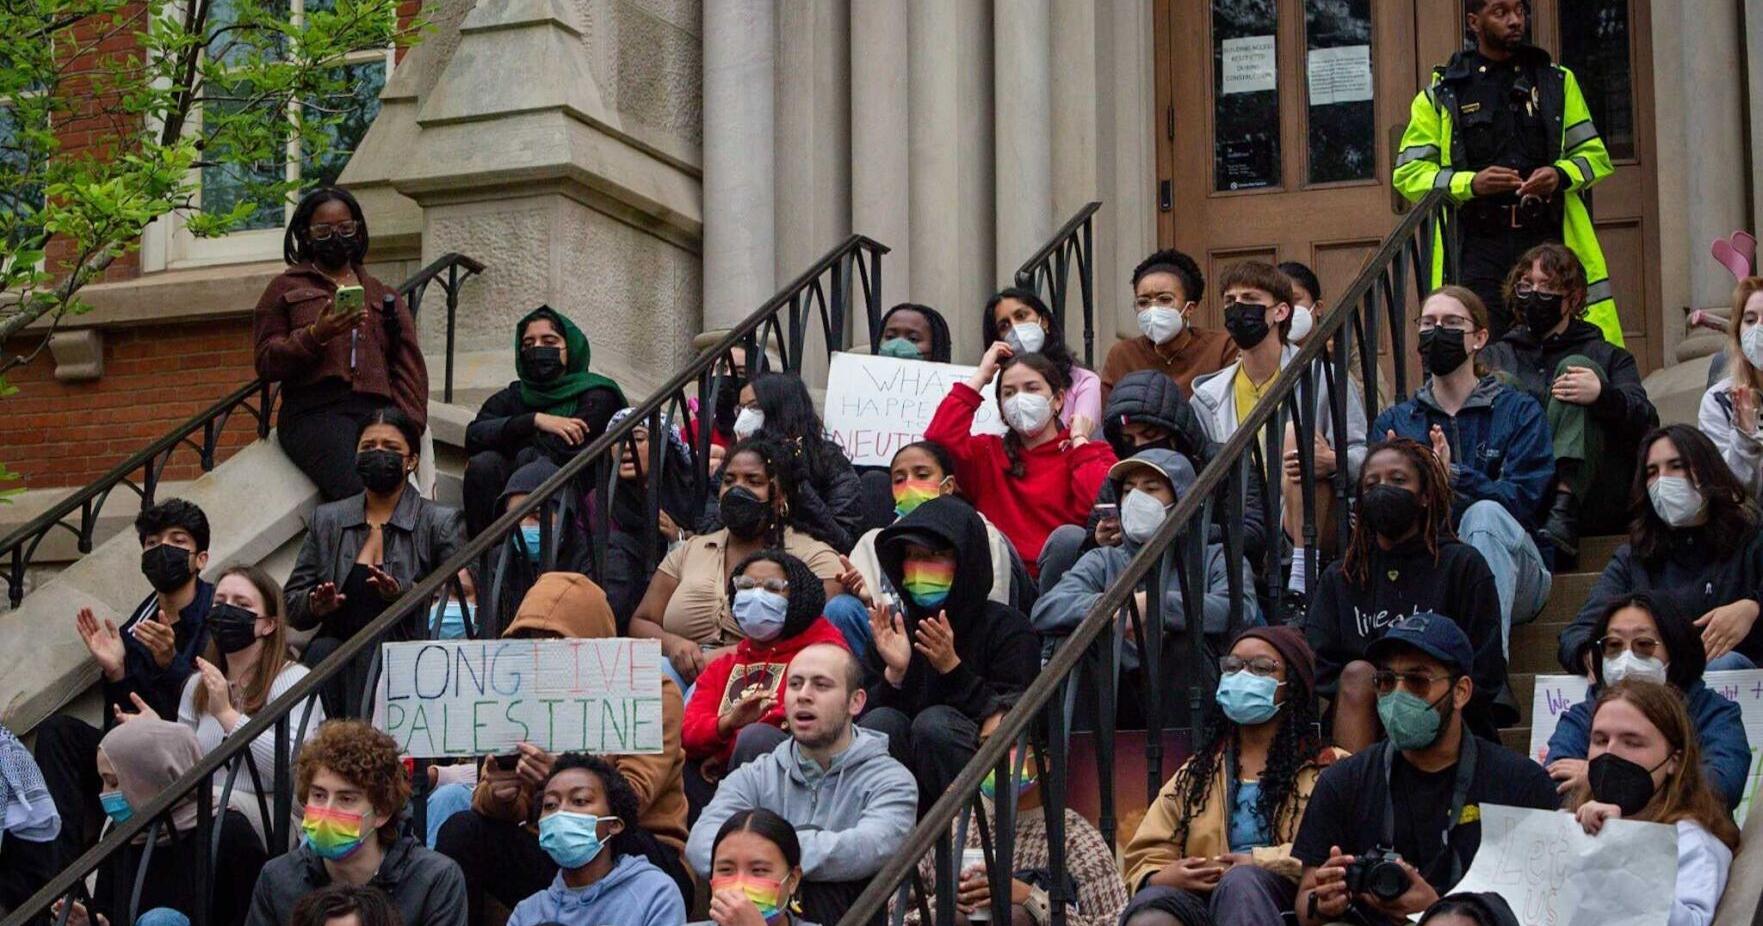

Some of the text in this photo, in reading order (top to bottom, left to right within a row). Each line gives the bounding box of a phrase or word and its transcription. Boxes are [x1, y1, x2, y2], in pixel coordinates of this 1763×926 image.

[842, 395, 992, 424] HAPPED
[387, 641, 658, 701] LONG LIVE
[387, 699, 663, 754] PALESTINE
